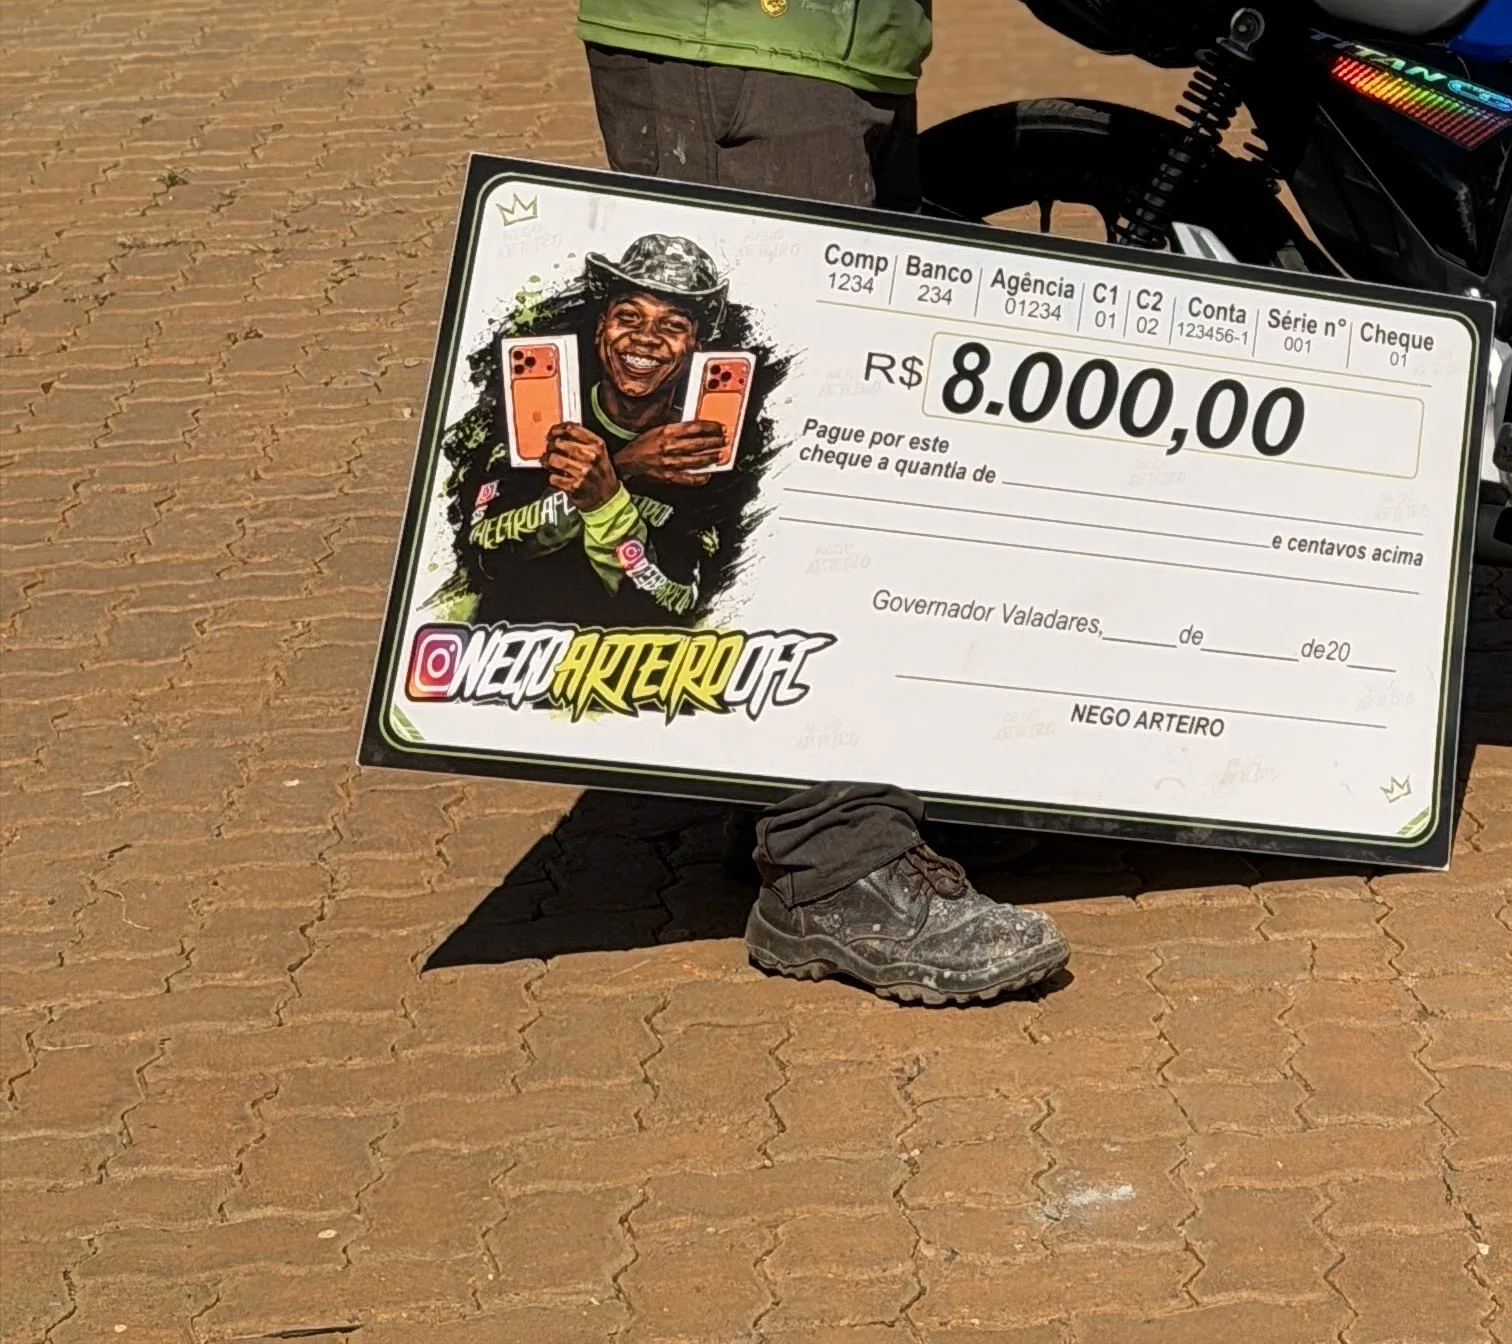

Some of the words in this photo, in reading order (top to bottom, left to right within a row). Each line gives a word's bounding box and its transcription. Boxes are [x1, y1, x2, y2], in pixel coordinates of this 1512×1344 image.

[1309, 27, 1447, 83] TITAN
[824, 243, 889, 277] Comp
[905, 254, 973, 285] Banco
[828, 272, 875, 295] 1234
[917, 284, 953, 306] 234
[990, 267, 1075, 300] Agência
[1092, 282, 1118, 306] C1
[1004, 297, 1062, 322] 01234
[1136, 287, 1164, 312] C2
[1187, 295, 1247, 325] Conta
[1094, 310, 1116, 330] 01
[1135, 316, 1159, 336] 02
[1177, 321, 1249, 346] 123456-1
[1267, 308, 1318, 335] Série
[1283, 335, 1312, 355] 001
[1359, 320, 1435, 352] Cheque
[1389, 350, 1408, 369] 01
[863, 351, 925, 391] R$
[941, 341, 1306, 458] 8.000,00
[801, 417, 866, 446] Pague
[867, 430, 905, 450] por
[908, 434, 951, 455] este
[799, 443, 873, 471] cheque
[876, 455, 890, 471] a
[894, 458, 967, 481] quantia
[972, 464, 997, 485] de
[1271, 533, 1283, 550] e
[1287, 534, 1368, 562] centavos
[1371, 545, 1424, 568] acima
[872, 588, 995, 624] Governador
[1001, 603, 1104, 638] Valadares,
[1179, 624, 1204, 646] de
[1071, 702, 1131, 729] NEGO
[1133, 709, 1225, 739] ARTEIRO
